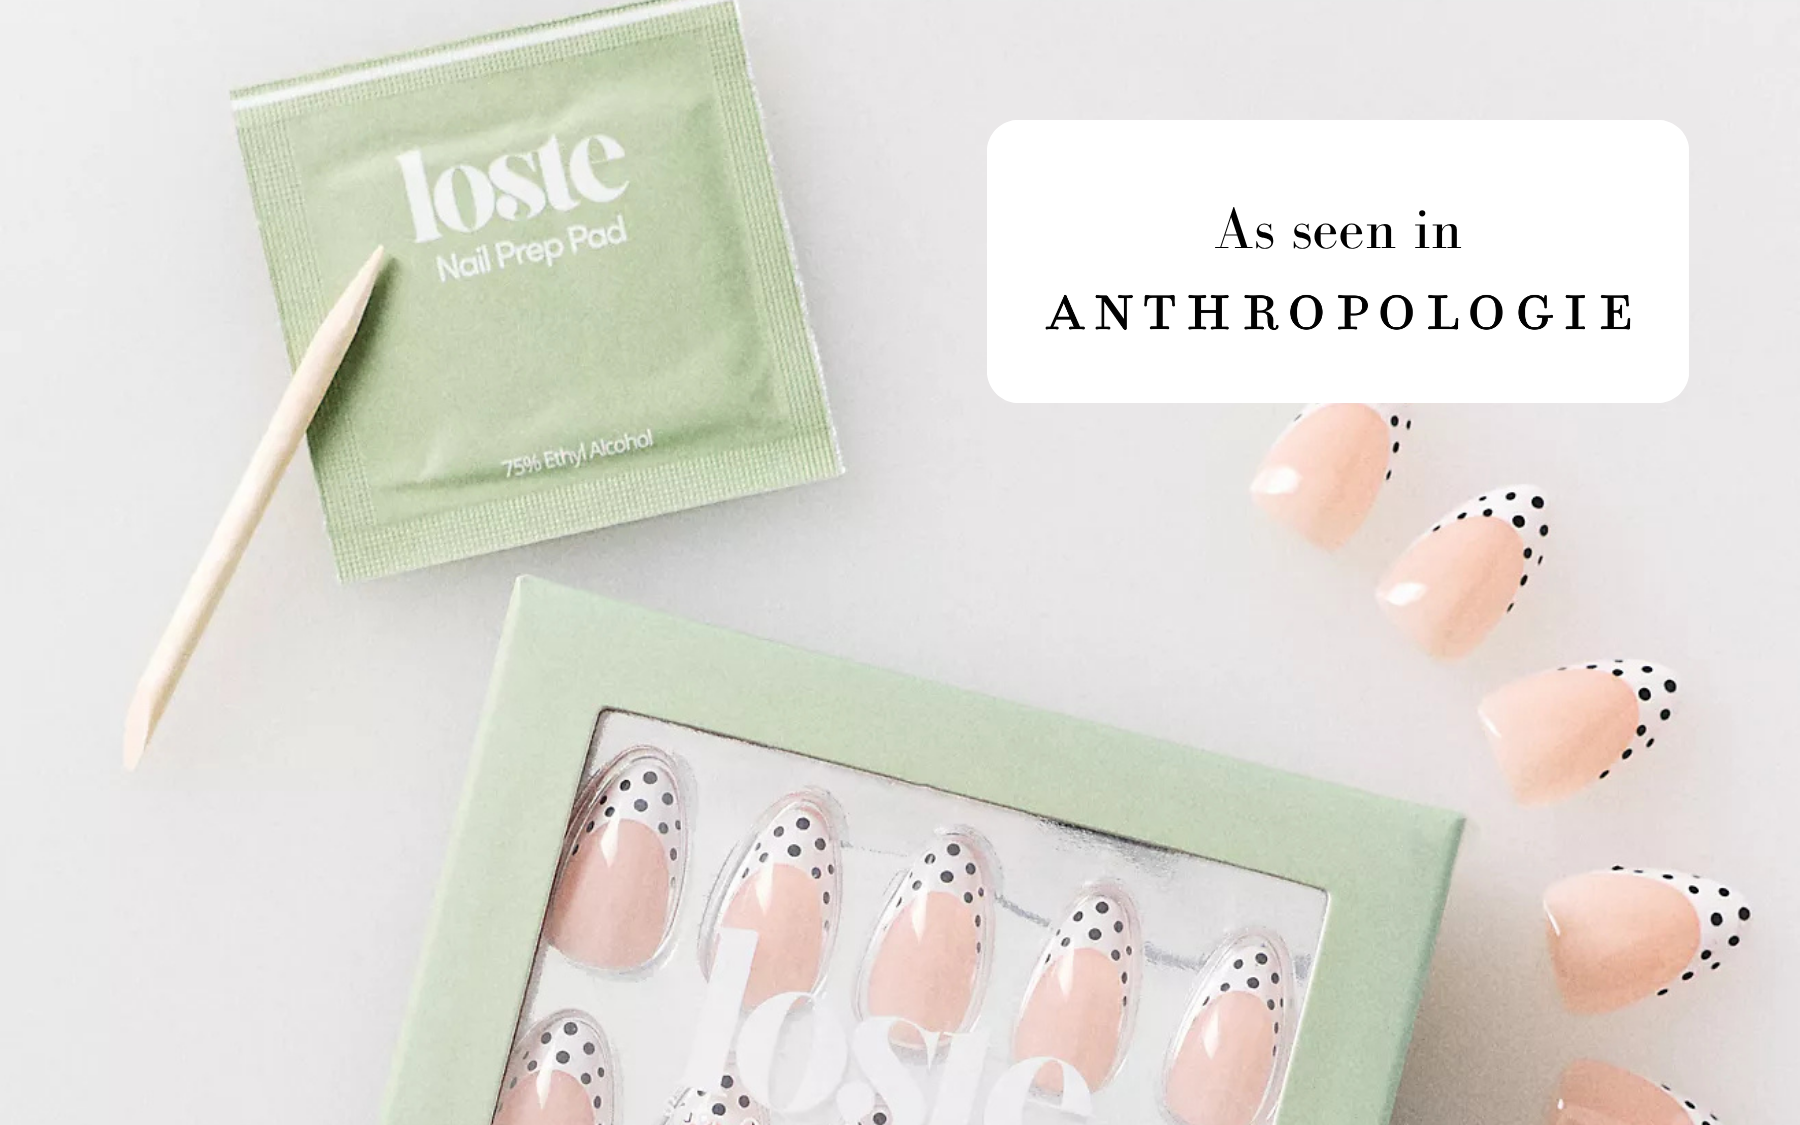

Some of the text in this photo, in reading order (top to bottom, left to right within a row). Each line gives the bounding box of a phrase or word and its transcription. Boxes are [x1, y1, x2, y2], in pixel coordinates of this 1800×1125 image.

[395, 133, 630, 243] loste
[436, 213, 627, 282] Nail Prep Pad
[501, 428, 653, 477] 75% Ethyl Alcohol
